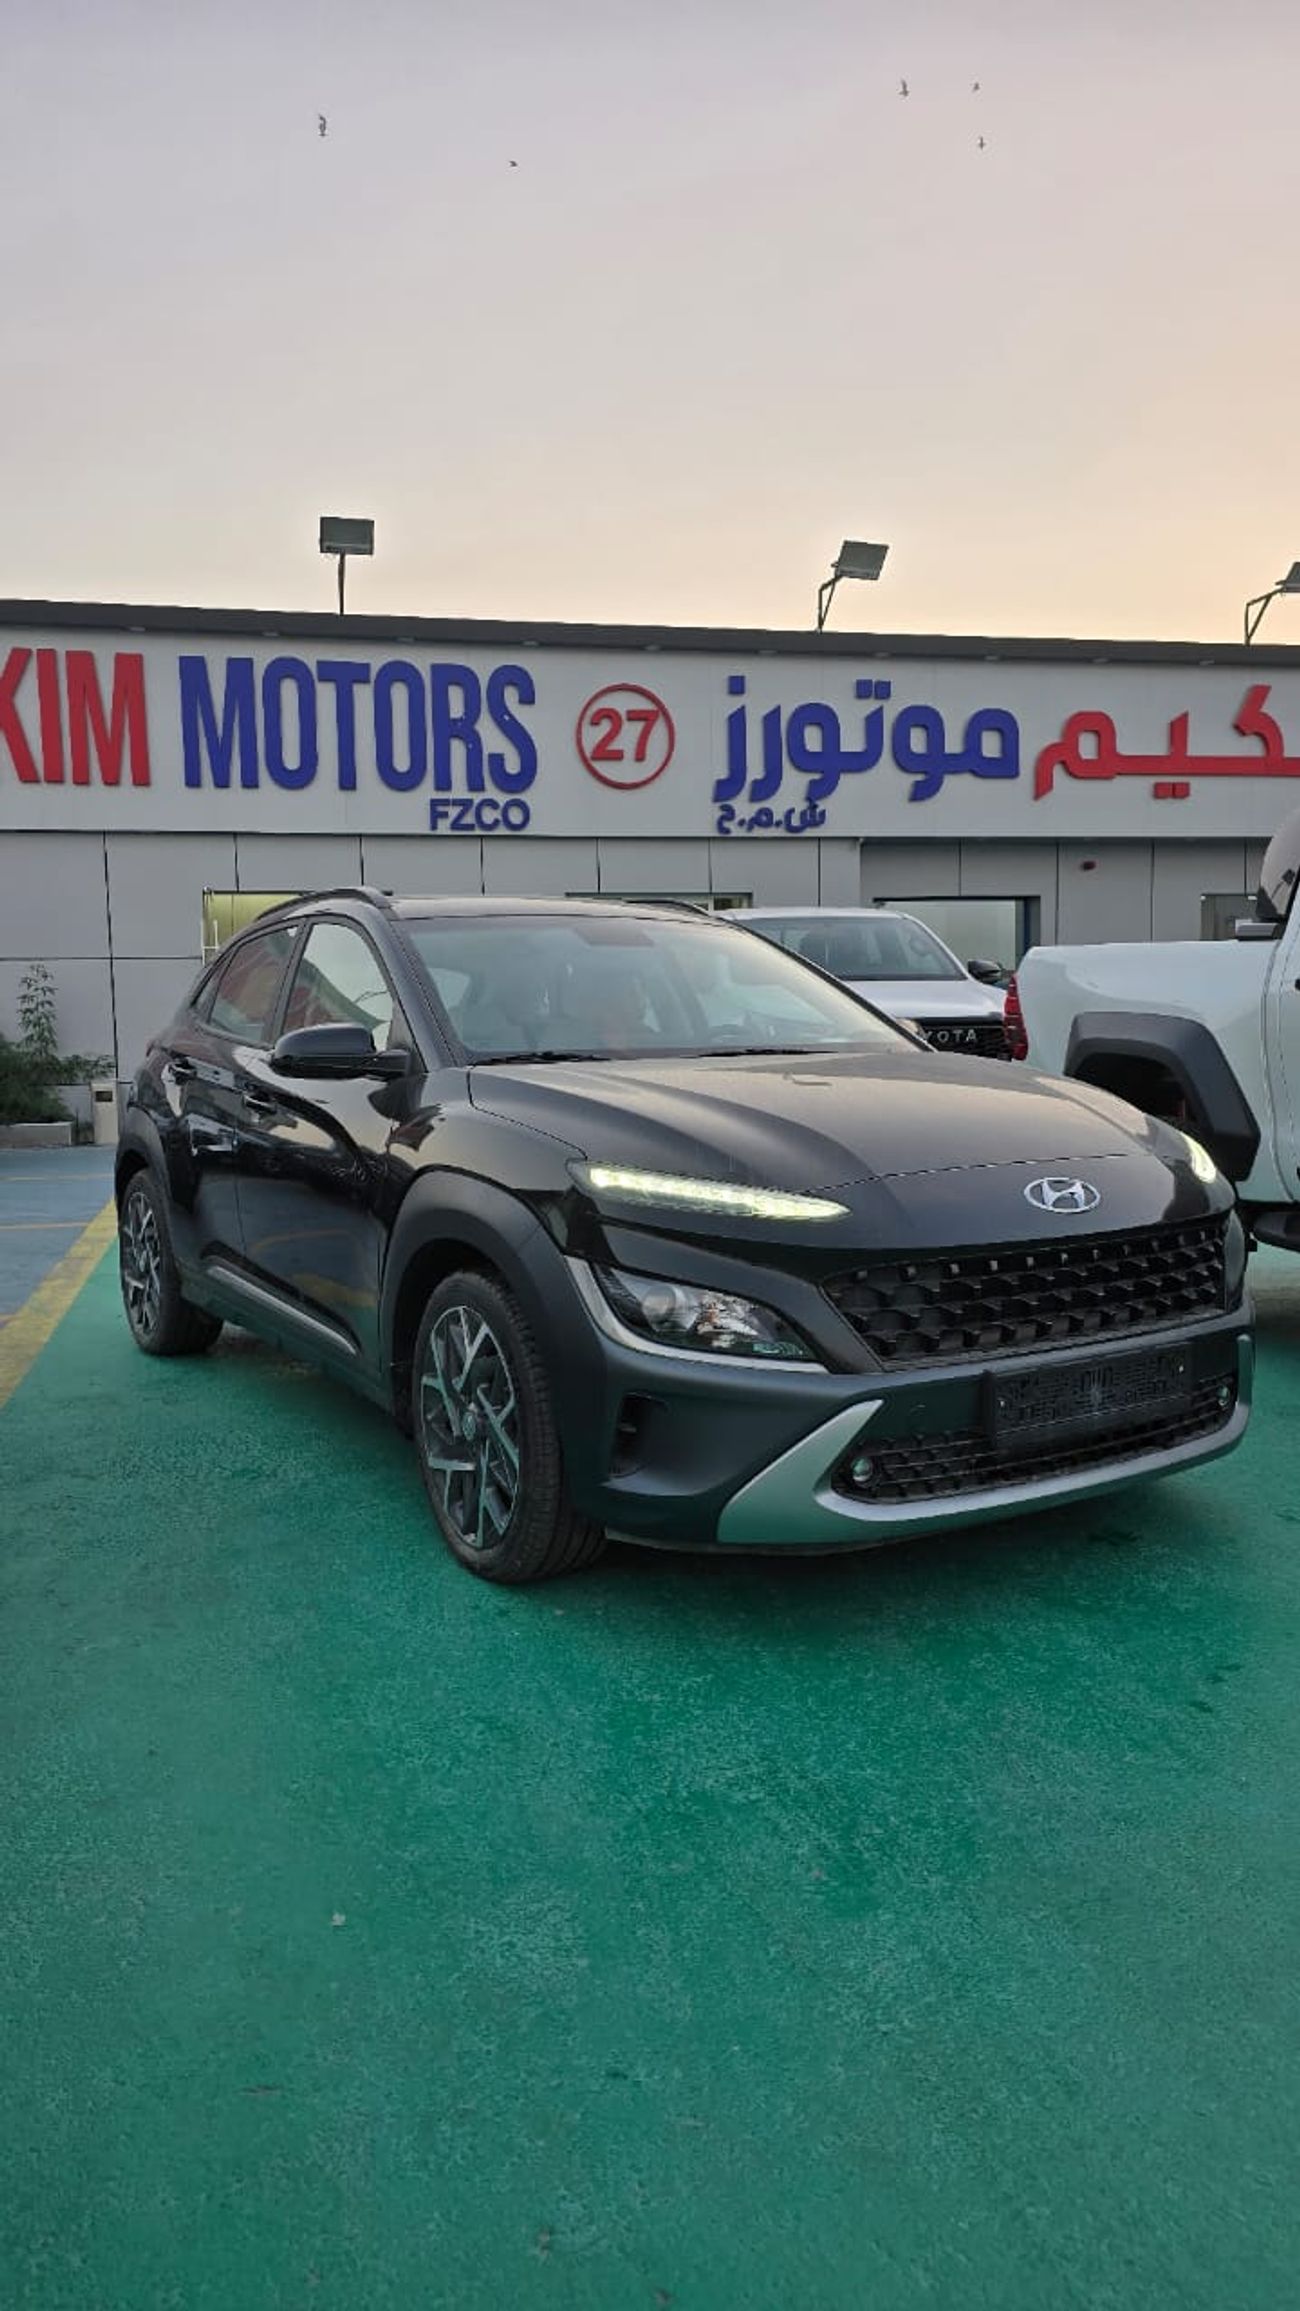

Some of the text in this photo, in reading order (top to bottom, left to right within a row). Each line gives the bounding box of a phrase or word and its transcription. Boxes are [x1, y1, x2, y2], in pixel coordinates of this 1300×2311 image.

[179, 655, 537, 794] MOTORS
[590, 707, 660, 763] 27
[712, 675, 1019, 803] موتورز
[430, 798, 531, 832] FZCO
